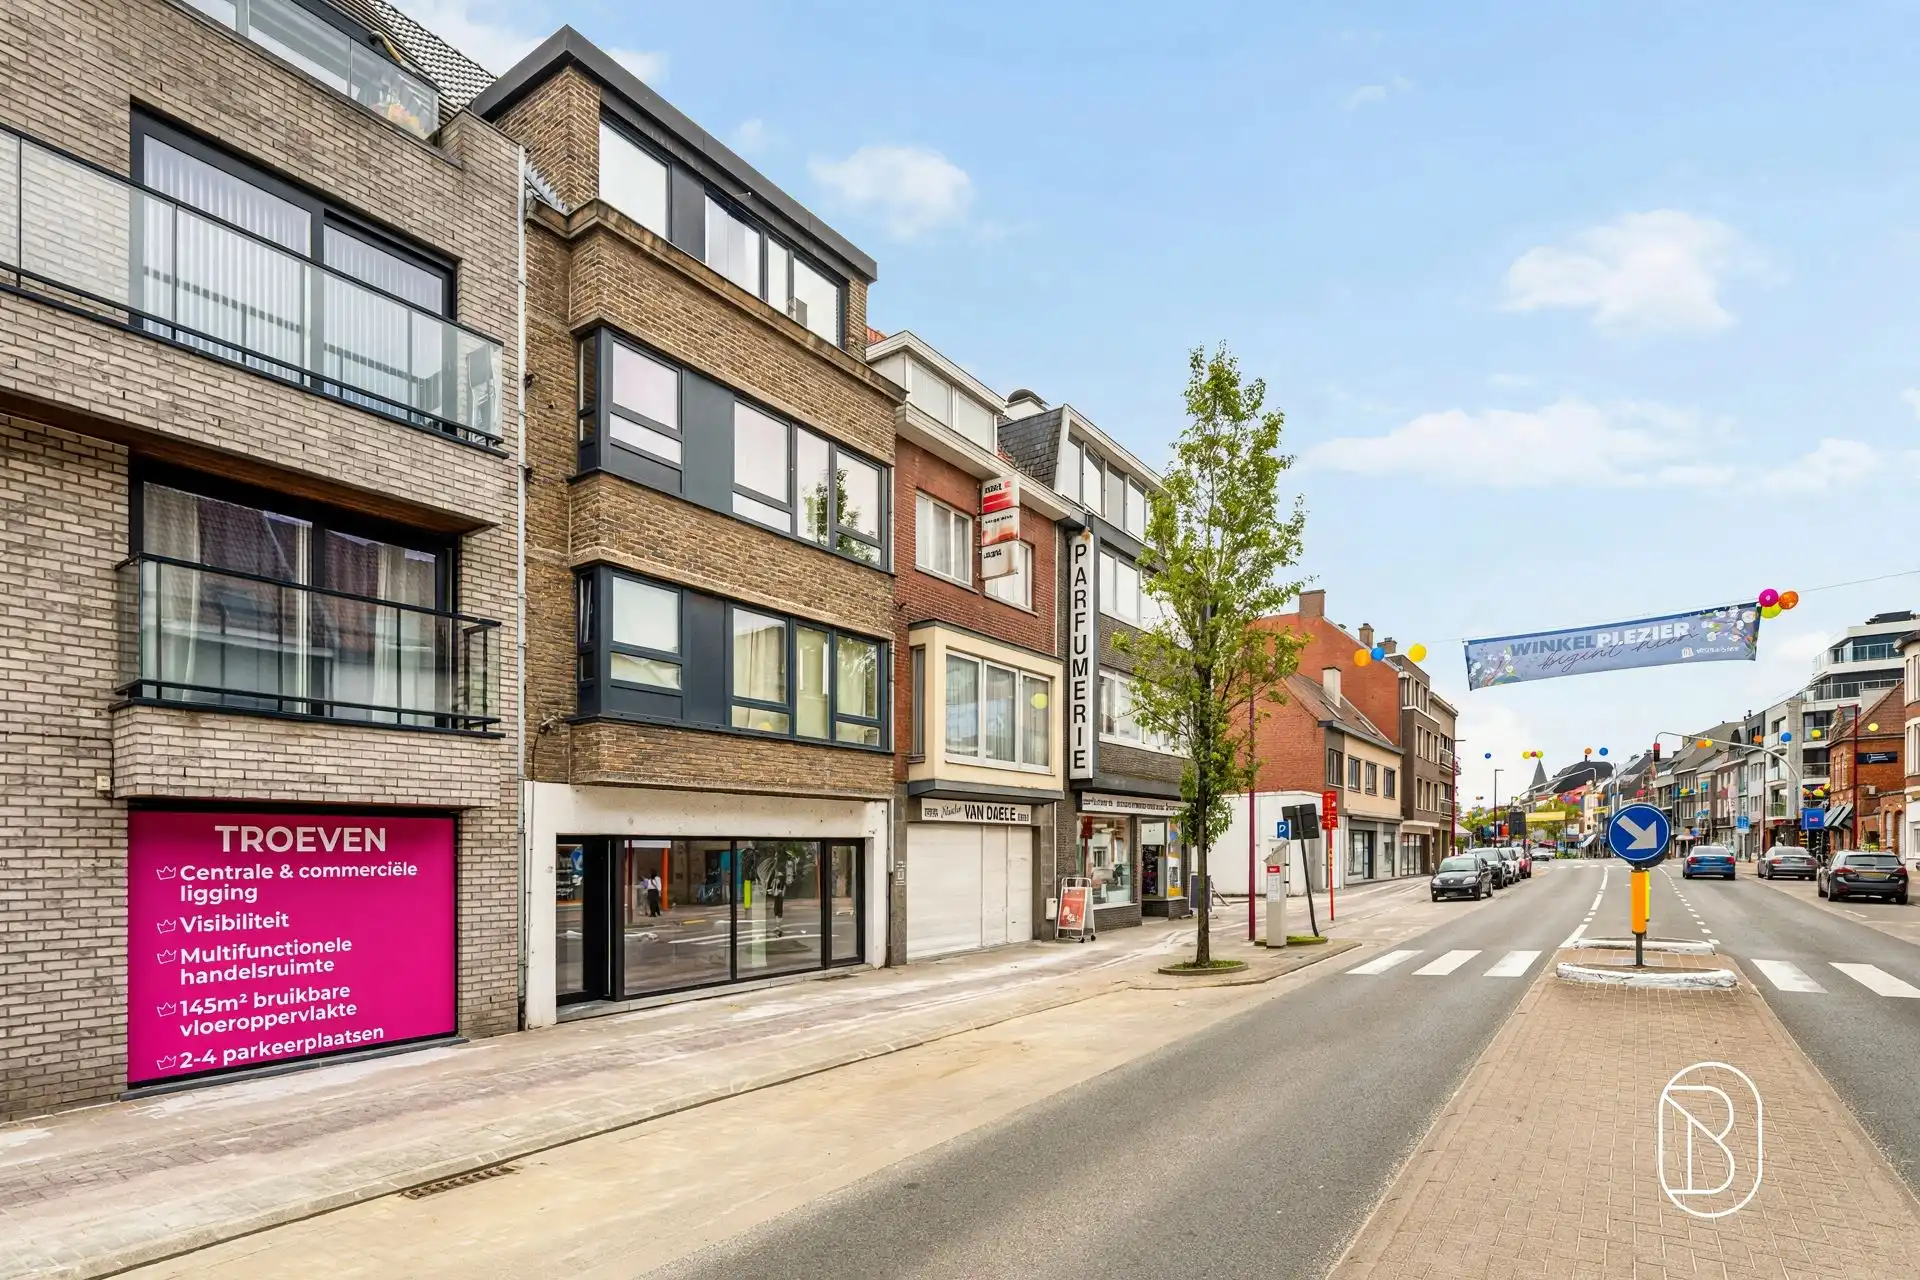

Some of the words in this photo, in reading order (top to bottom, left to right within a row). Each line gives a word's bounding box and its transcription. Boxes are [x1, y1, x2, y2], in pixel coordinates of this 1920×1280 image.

[1510, 622, 1690, 657] WINKELPLEZIER
[1072, 543, 1088, 770] PARFUMERIE
[964, 804, 984, 820] VAN
[215, 826, 386, 853] TROEVEN
[180, 864, 274, 882] Centrale
[279, 863, 294, 879] &
[298, 860, 418, 879] commerciële
[180, 883, 258, 906] ligging
[180, 910, 290, 933] Visibiliteit
[180, 937, 352, 965] Multifunctionele
[180, 958, 335, 986] handelsruimte
[180, 993, 248, 1017] 145m²
[253, 984, 351, 1009] bruikbare
[179, 1002, 358, 1037] vloeroppervlakte
[179, 1048, 218, 1069] 2-4
[223, 1026, 384, 1066] parkeerplaatsen
